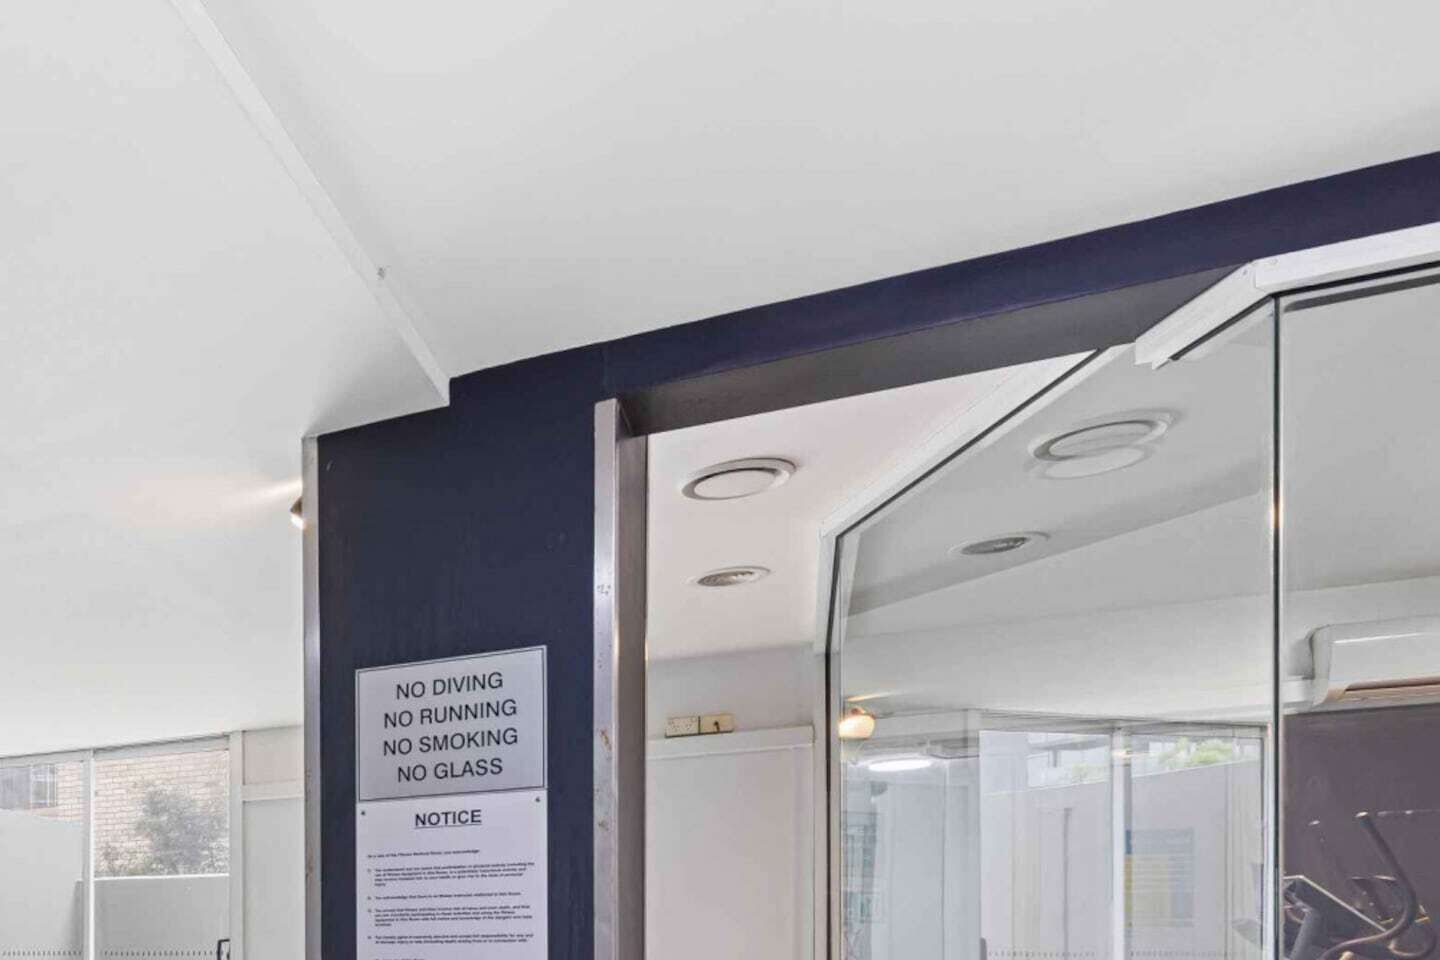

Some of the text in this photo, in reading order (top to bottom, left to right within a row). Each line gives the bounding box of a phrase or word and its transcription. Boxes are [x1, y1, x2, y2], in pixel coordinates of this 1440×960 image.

[397, 672, 503, 699] NO DIVING
[384, 700, 517, 728] NO RUNNING
[384, 728, 518, 755] NO SMOKING
[398, 758, 503, 782] NO GLASS
[415, 810, 482, 826] NOTICE
